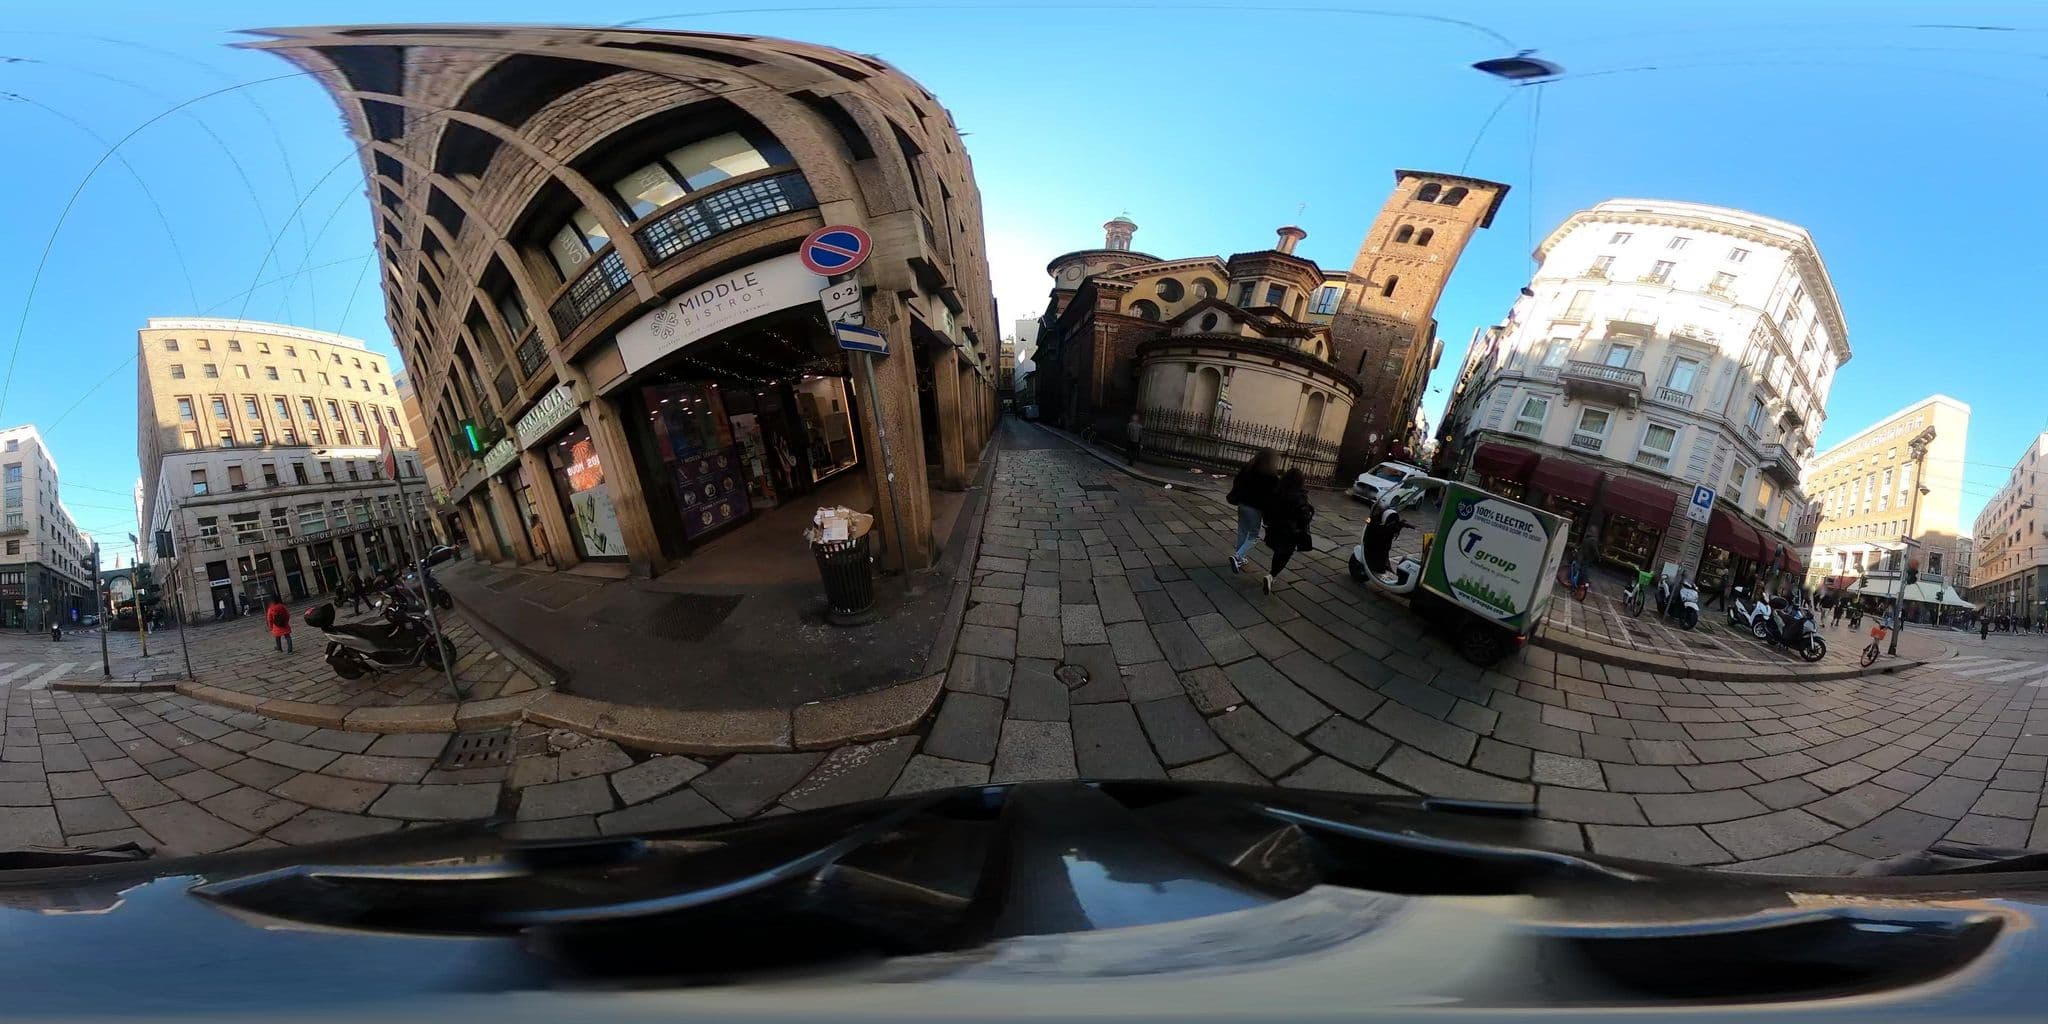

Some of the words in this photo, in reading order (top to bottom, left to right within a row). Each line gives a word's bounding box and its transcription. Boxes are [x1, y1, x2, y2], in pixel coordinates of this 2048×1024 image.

[678, 272, 758, 315] MIDDLE
[684, 288, 767, 327] BISTROT
[518, 387, 565, 438] FARMACIA
[1697, 489, 1710, 504] P
[1475, 506, 1495, 519] 100%
[1495, 512, 1534, 533] ELECTRIC
[1464, 532, 1483, 554] T
[1474, 550, 1517, 572] group
